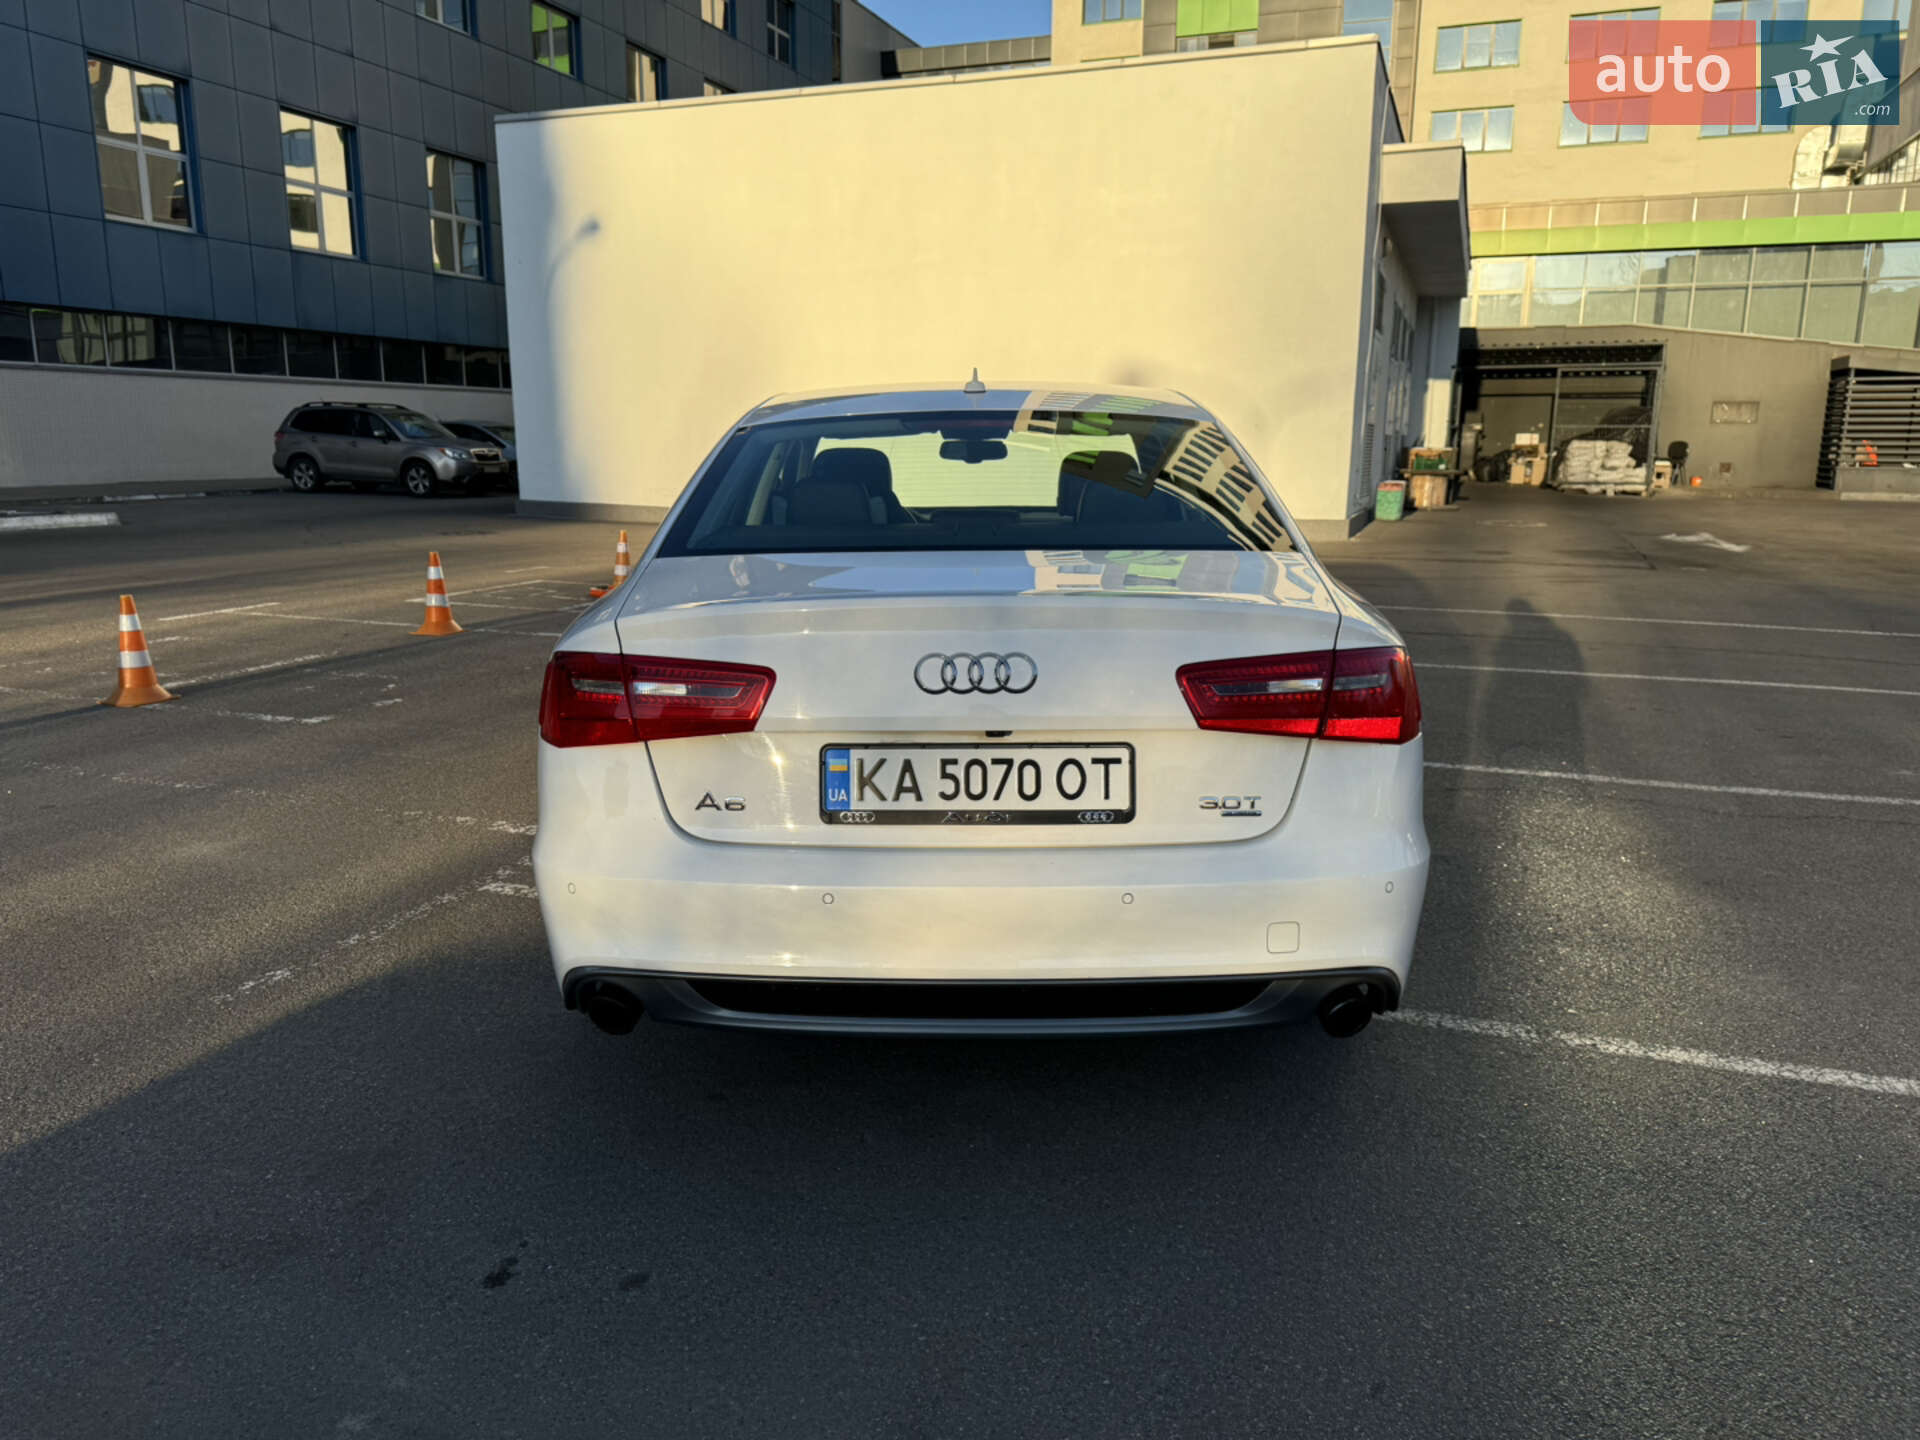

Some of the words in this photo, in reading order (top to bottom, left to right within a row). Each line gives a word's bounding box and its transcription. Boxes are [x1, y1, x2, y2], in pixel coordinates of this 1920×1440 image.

[856, 757, 923, 802] KA
[937, 757, 1042, 801] 5070
[1055, 757, 1122, 801] OT
[695, 792, 745, 811] A6
[828, 788, 848, 802] UA
